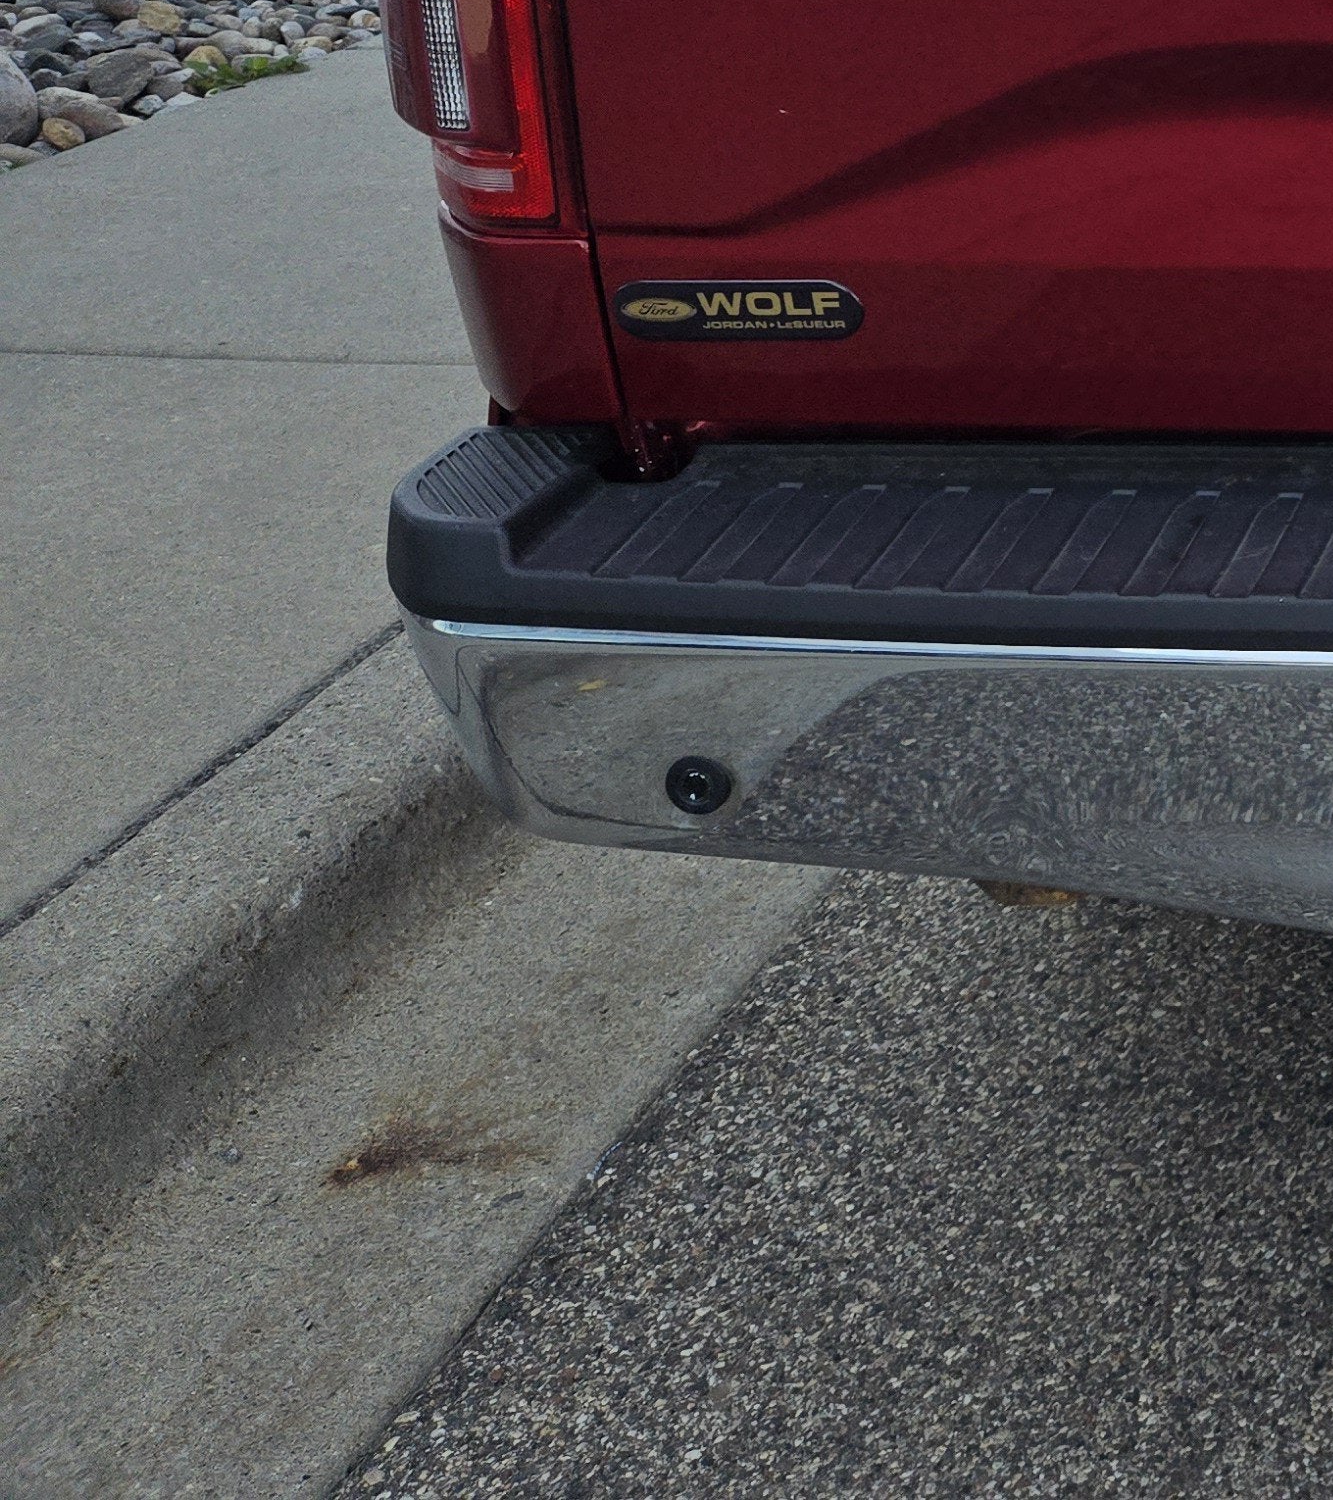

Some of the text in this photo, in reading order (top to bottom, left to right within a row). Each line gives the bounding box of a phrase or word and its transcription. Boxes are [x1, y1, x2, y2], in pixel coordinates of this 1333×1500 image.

[639, 292, 840, 316] Ford WOLF
[703, 321, 767, 329] JORDAN
